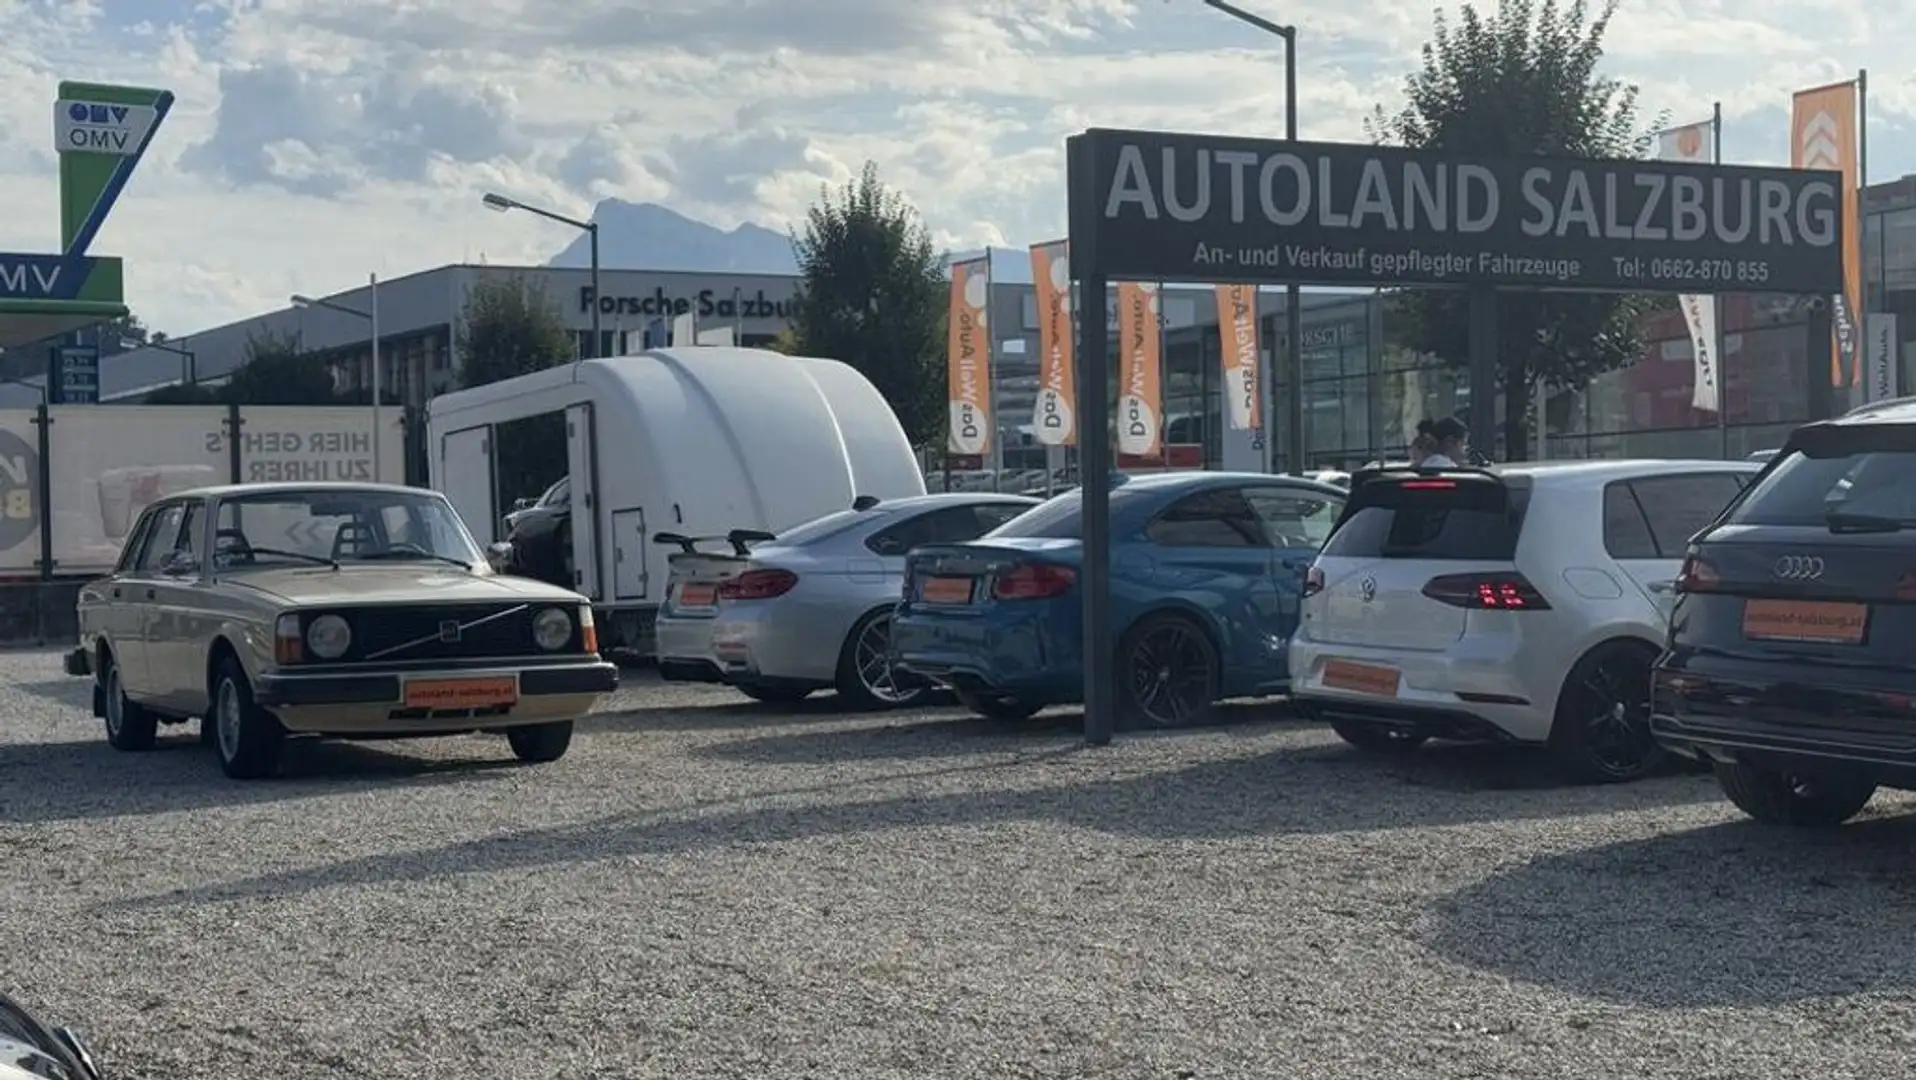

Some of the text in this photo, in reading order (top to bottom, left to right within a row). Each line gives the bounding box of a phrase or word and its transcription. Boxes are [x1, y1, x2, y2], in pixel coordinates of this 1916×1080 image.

[70, 128, 128, 150] OMV
[1104, 144, 1835, 247] AUTOLAND SALZBURG
[1194, 243, 1232, 264] An-
[1238, 245, 1279, 267] und
[1286, 245, 1364, 269] Verkauf
[1370, 249, 1472, 277] gepflegter
[1479, 253, 1580, 279] Fahrzeuge
[1613, 257, 1646, 279] Tel:
[1737, 261, 1769, 281] 855
[580, 285, 690, 316] Porsche
